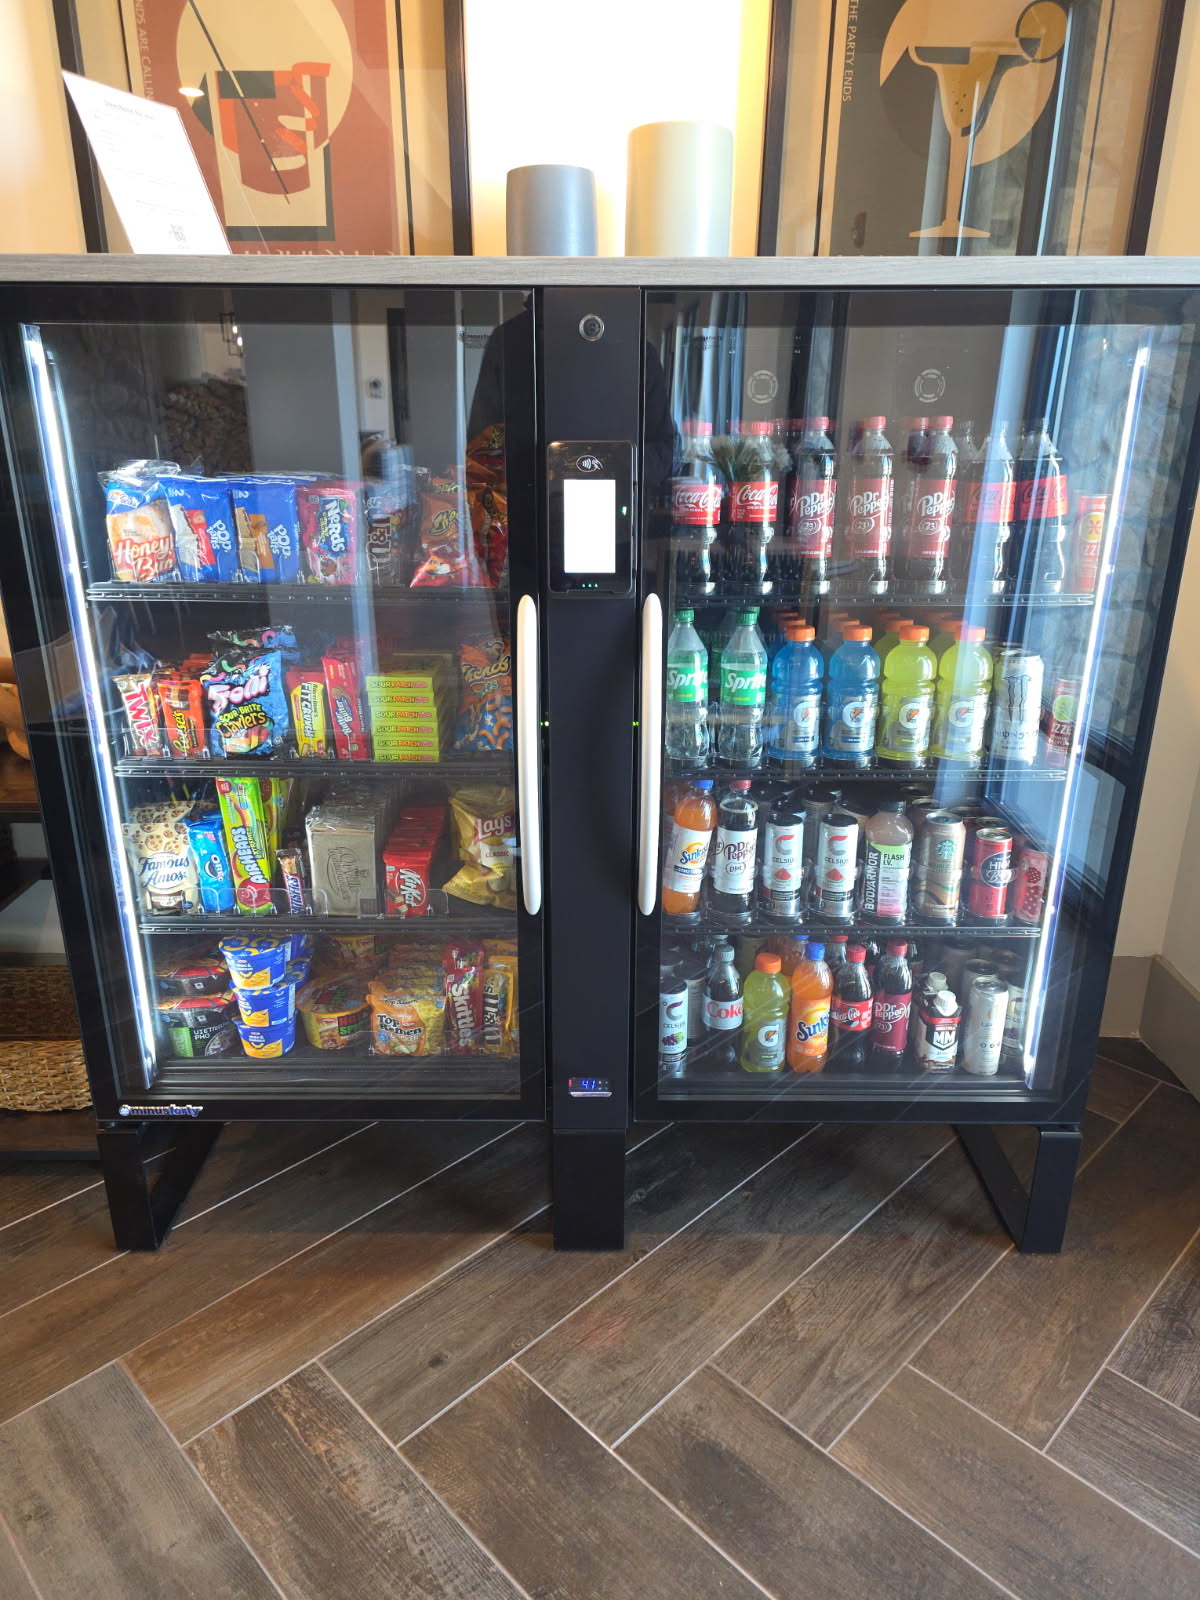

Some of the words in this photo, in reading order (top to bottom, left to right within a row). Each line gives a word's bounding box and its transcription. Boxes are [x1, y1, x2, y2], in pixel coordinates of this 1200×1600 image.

[848, 0, 858, 21] THE
[140, 29, 149, 52] ARE
[846, 26, 856, 65] PARTY
[842, 70, 853, 102] ENDS
[810, 492, 827, 506] Dr
[863, 491, 880, 504] Dr
[725, 672, 767, 693] Sprite
[219, 709, 239, 722] SOUR
[737, 841, 750, 852] Dr
[883, 853, 905, 861] FLASH
[864, 851, 879, 911] BODYARMOR
[451, 982, 472, 1047] Skittles
[706, 1001, 743, 1020] Coke
[874, 1002, 906, 1020] Pepper
[883, 1002, 897, 1013] Dr
[377, 1014, 399, 1027] Top
[194, 1032, 211, 1041] PHO
